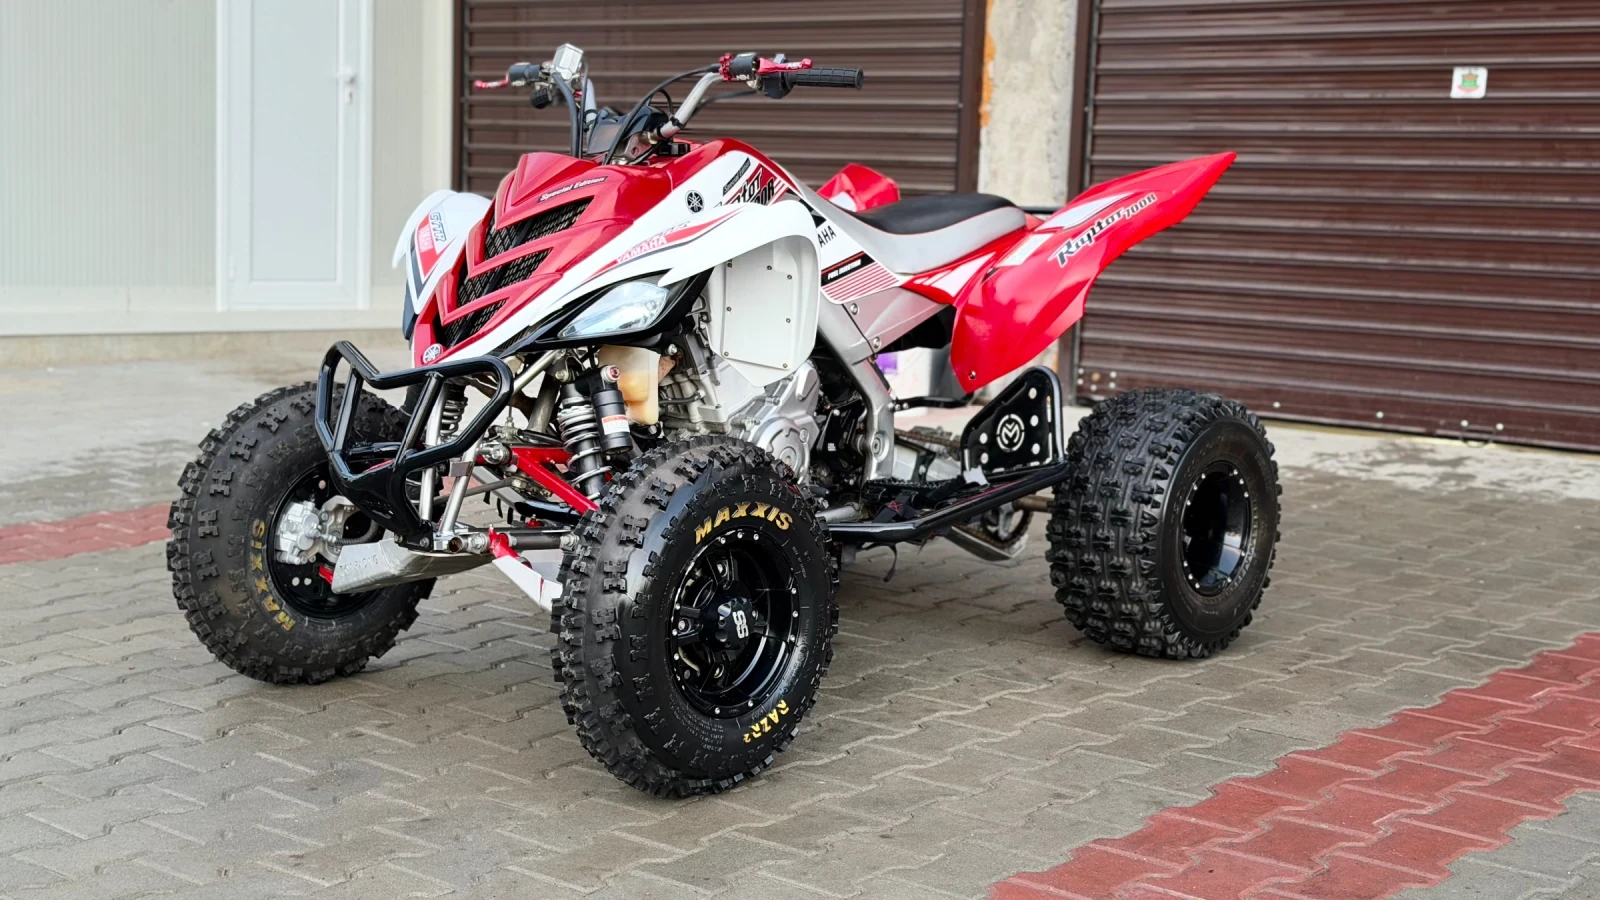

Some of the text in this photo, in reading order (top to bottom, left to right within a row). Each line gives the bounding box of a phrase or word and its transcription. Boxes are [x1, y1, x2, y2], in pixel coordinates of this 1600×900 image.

[540, 177, 606, 201] Special Edition
[616, 235, 668, 264] YAMAHA
[1047, 208, 1125, 268] Raptor
[694, 501, 793, 545] MAXXIS
[251, 519, 297, 631] MAXXIS
